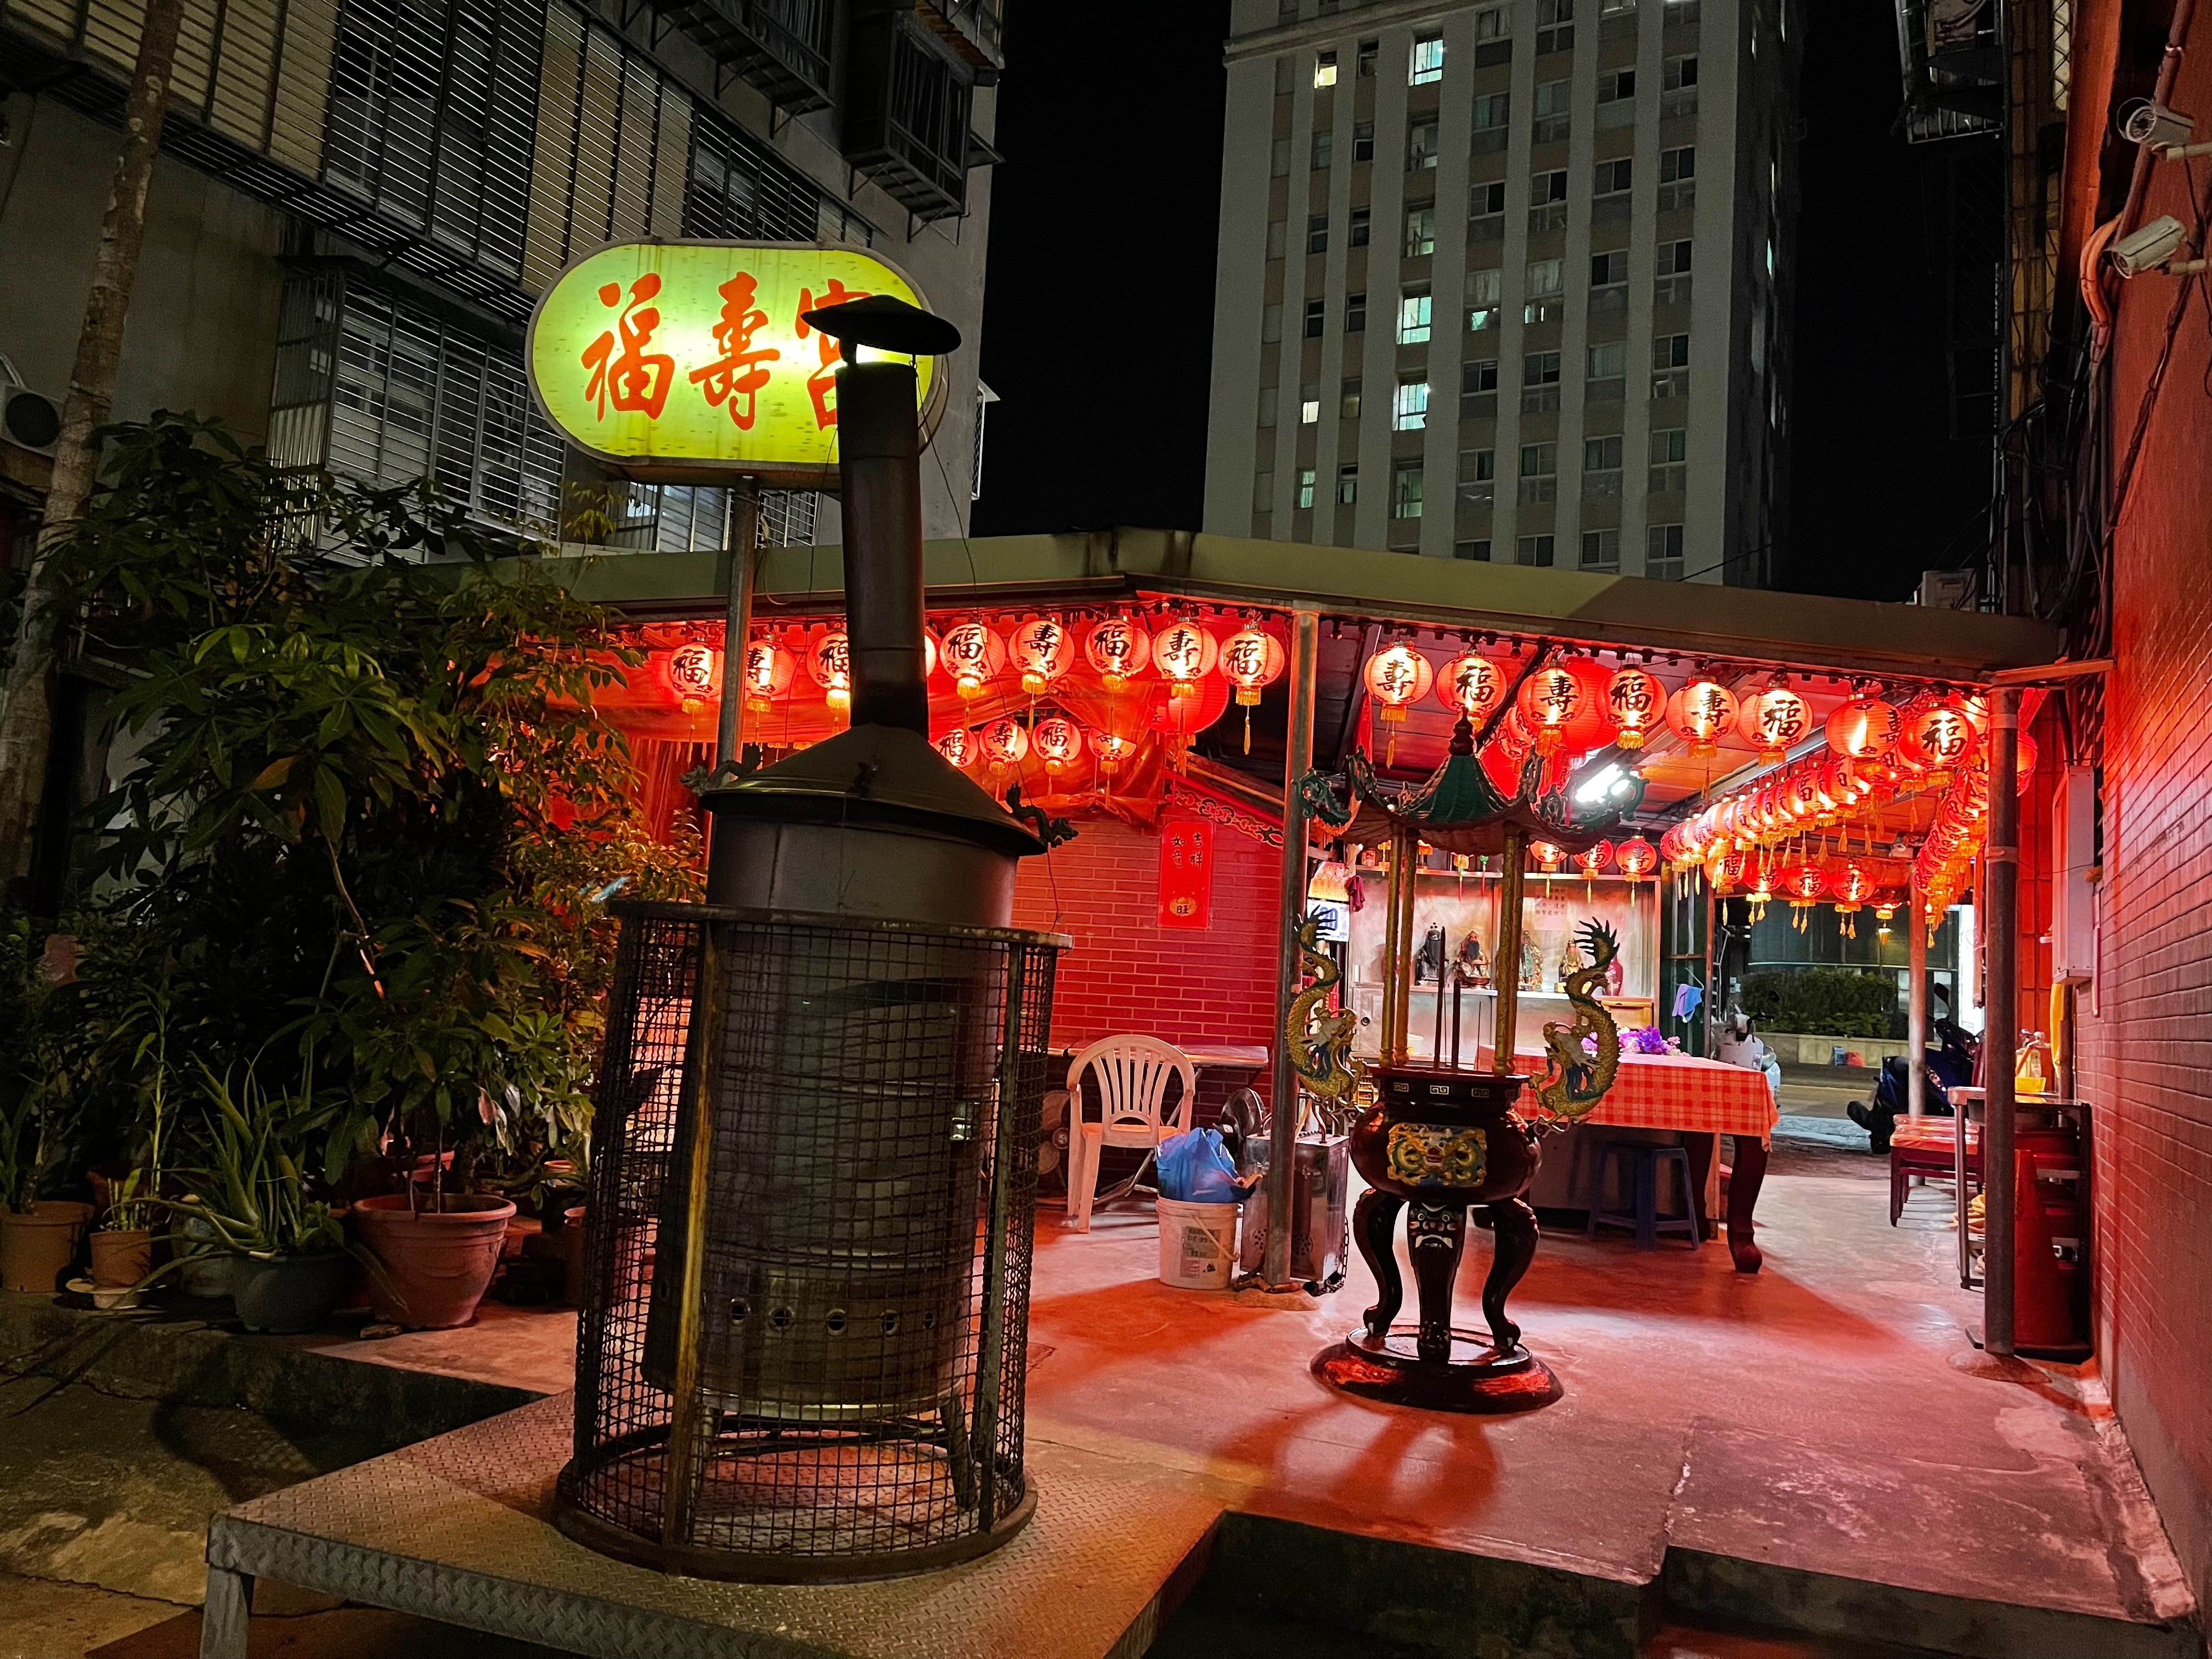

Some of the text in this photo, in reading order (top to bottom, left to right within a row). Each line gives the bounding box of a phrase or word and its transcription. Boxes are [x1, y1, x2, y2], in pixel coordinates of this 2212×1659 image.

[948, 627, 983, 659] 福
[1023, 623, 1059, 658] 壽
[1094, 621, 1131, 658] 福
[1163, 629, 1199, 665] 壽
[1226, 639, 1261, 675] 福
[673, 648, 708, 684] 福
[1376, 659, 1414, 697] 壽
[1456, 665, 1494, 703] 福
[1539, 675, 1578, 713] 壽
[1610, 676, 1652, 712] 福
[1691, 689, 1730, 727] 壽
[988, 720, 1014, 744] 壽
[1041, 721, 1068, 747] 福
[1764, 699, 1803, 737] 福
[939, 731, 967, 758] 福
[1921, 718, 1966, 756] 福
[1170, 832, 1186, 868] 如意
[1189, 832, 1203, 871] 吉祥
[1628, 845, 1650, 867] 壽
[1799, 871, 1820, 892] 福
[1841, 873, 1865, 895] 壽
[1176, 905, 1189, 915] 旺
